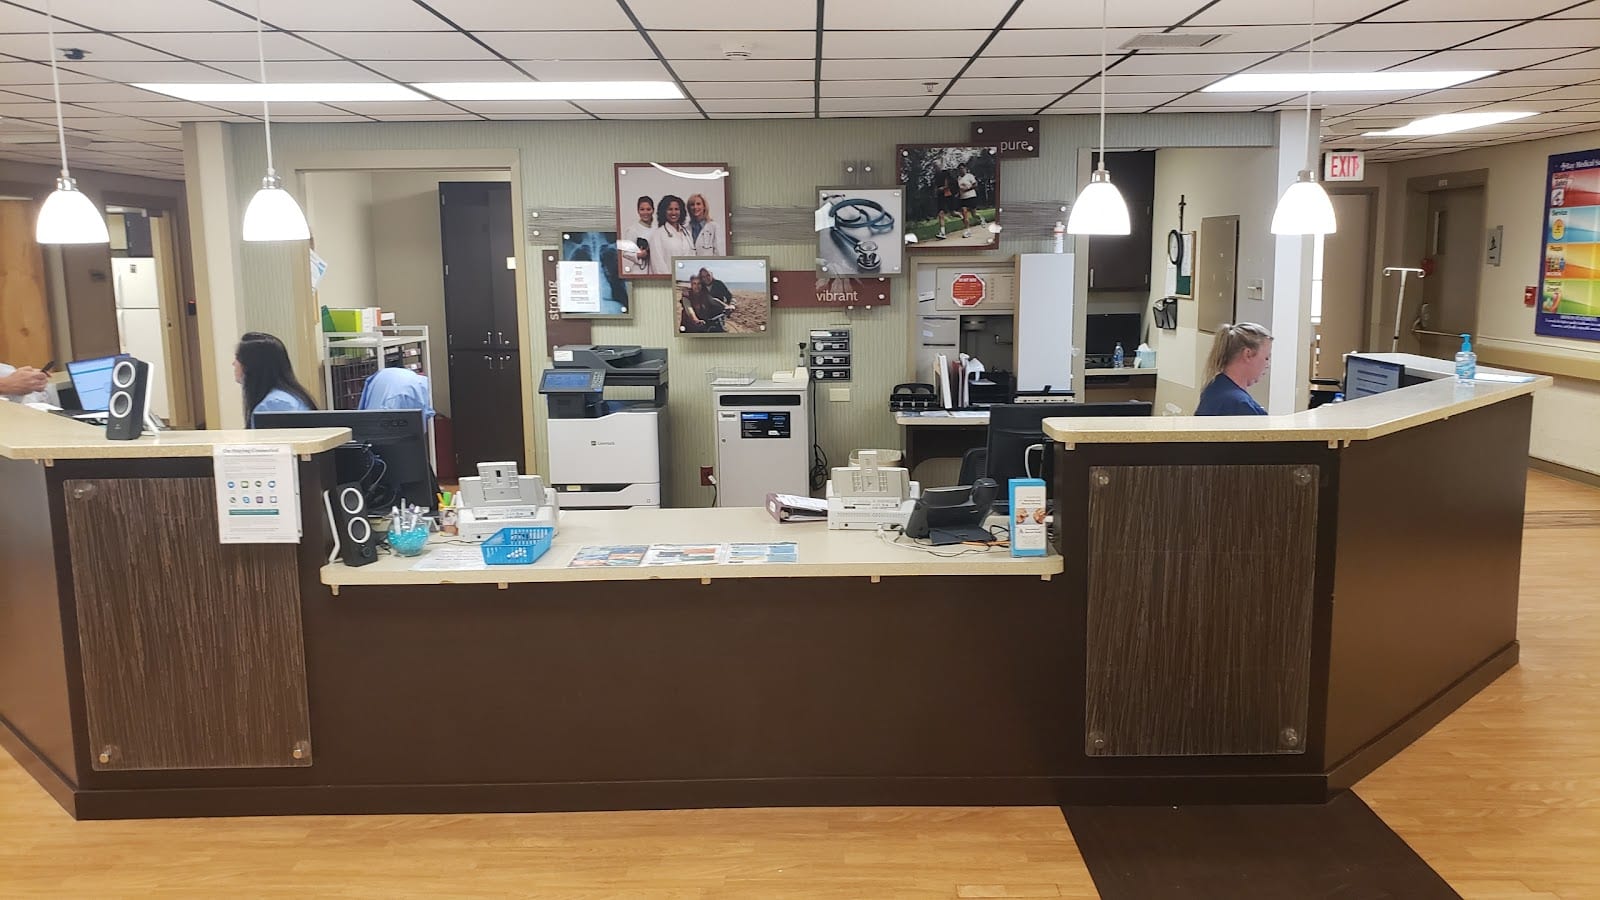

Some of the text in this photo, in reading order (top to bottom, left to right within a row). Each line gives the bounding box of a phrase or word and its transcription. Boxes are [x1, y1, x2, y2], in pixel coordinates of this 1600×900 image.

[1000, 141, 1029, 153] pure
[1331, 155, 1359, 177] EXIT
[816, 290, 859, 302] vibrant
